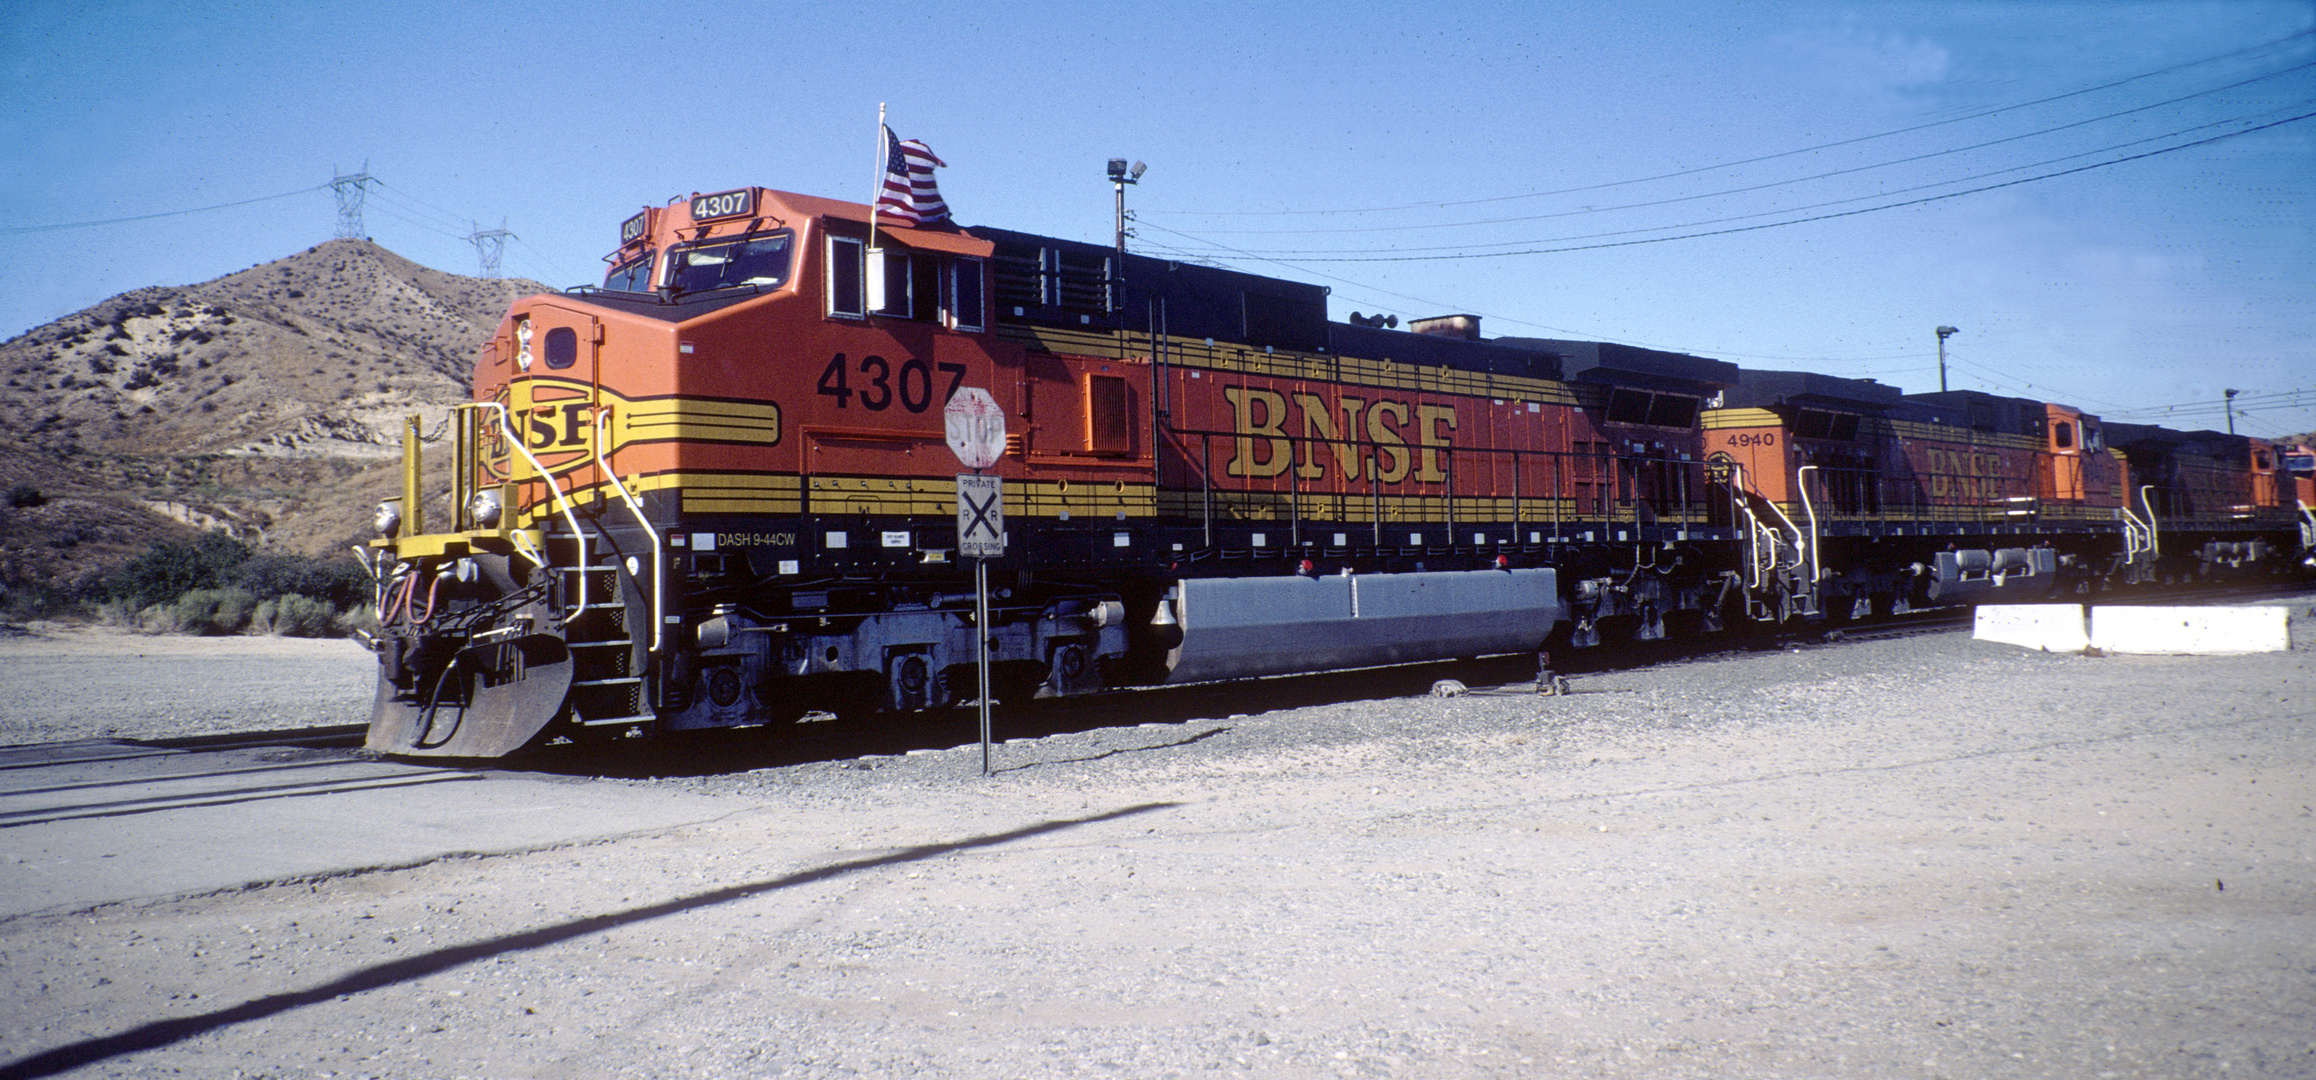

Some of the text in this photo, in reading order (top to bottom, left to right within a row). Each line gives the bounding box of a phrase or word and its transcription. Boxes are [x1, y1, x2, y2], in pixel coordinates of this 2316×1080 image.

[694, 191, 747, 218] 4307
[622, 215, 645, 241] 4307
[816, 352, 967, 414] 4307
[948, 412, 1002, 444] STOP
[1224, 384, 1459, 485] BNSF
[1727, 433, 1775, 447] 4940
[962, 479, 996, 489] PRIVATE
[1927, 448, 2001, 499] BNSF
[962, 509, 998, 521] R R
[717, 532, 796, 546] DASH 9-44CW
[962, 541, 1001, 551] CROSSING
